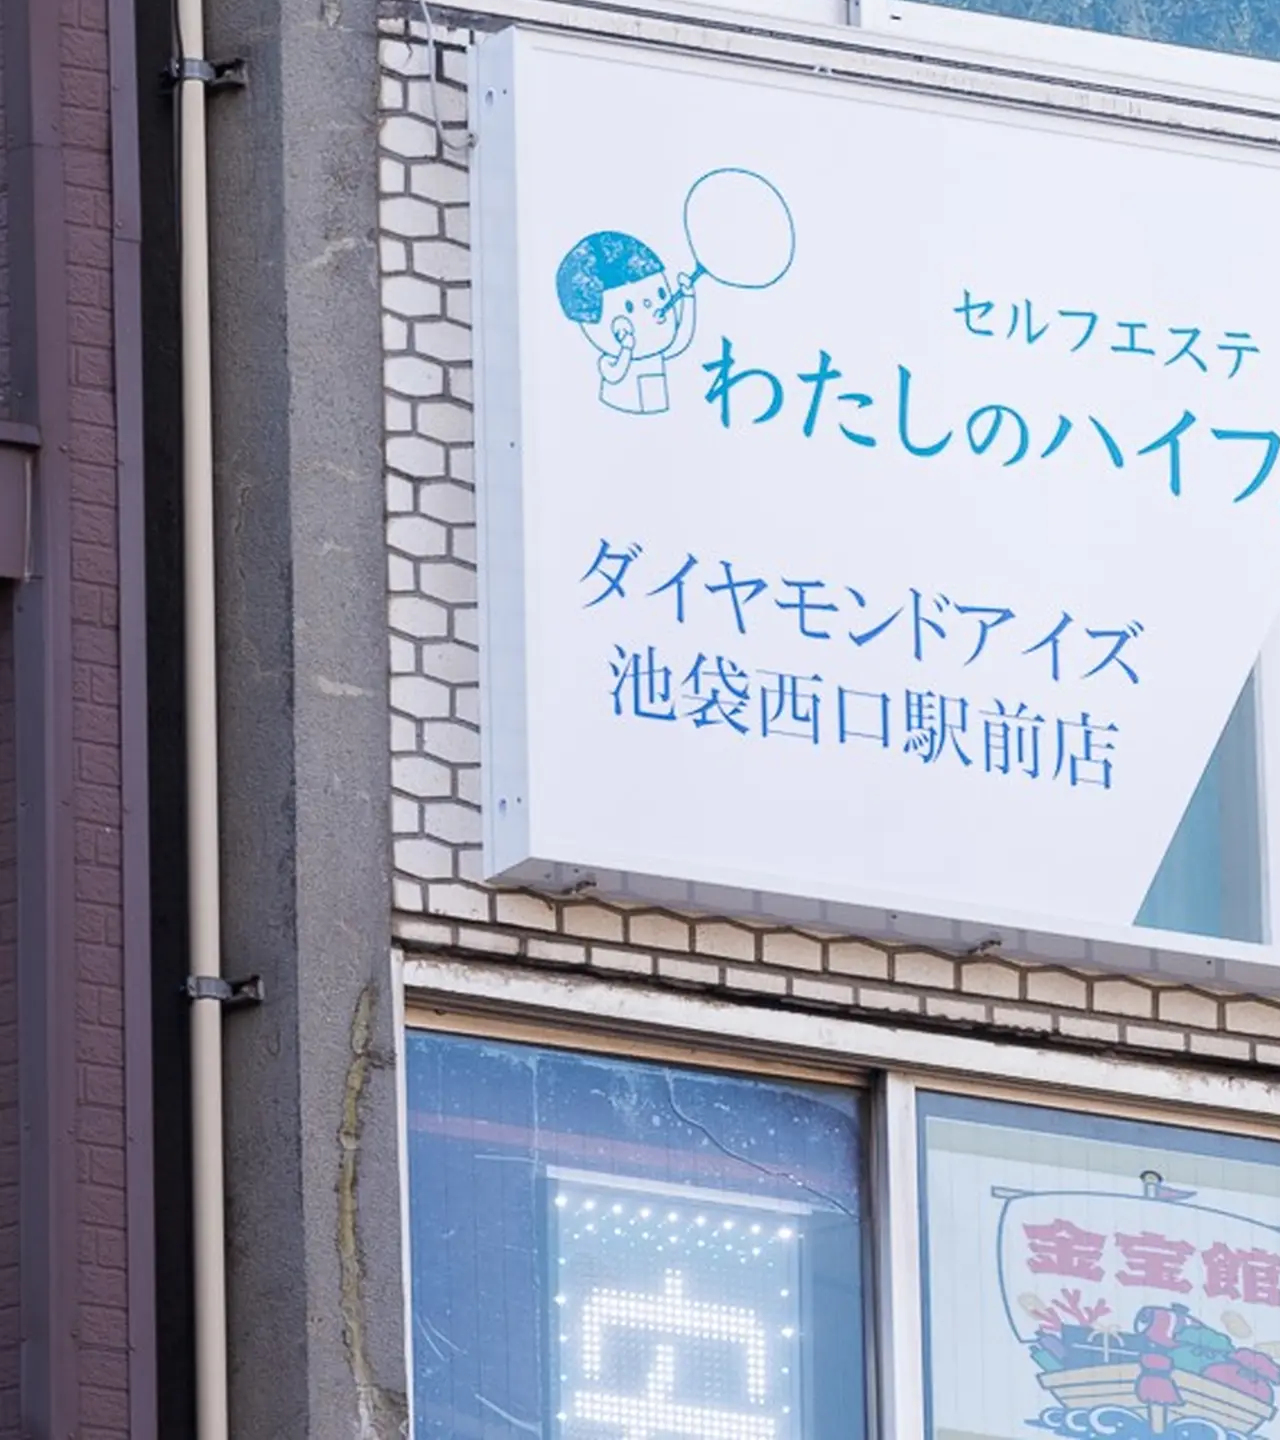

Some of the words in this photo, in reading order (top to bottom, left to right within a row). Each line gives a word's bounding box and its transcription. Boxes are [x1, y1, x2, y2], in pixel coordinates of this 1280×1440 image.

[953, 288, 1260, 379] セルフエステ
[579, 536, 1145, 686] ダイヤモンドアイズ
[608, 643, 1121, 791] 池袋西口駅前店
